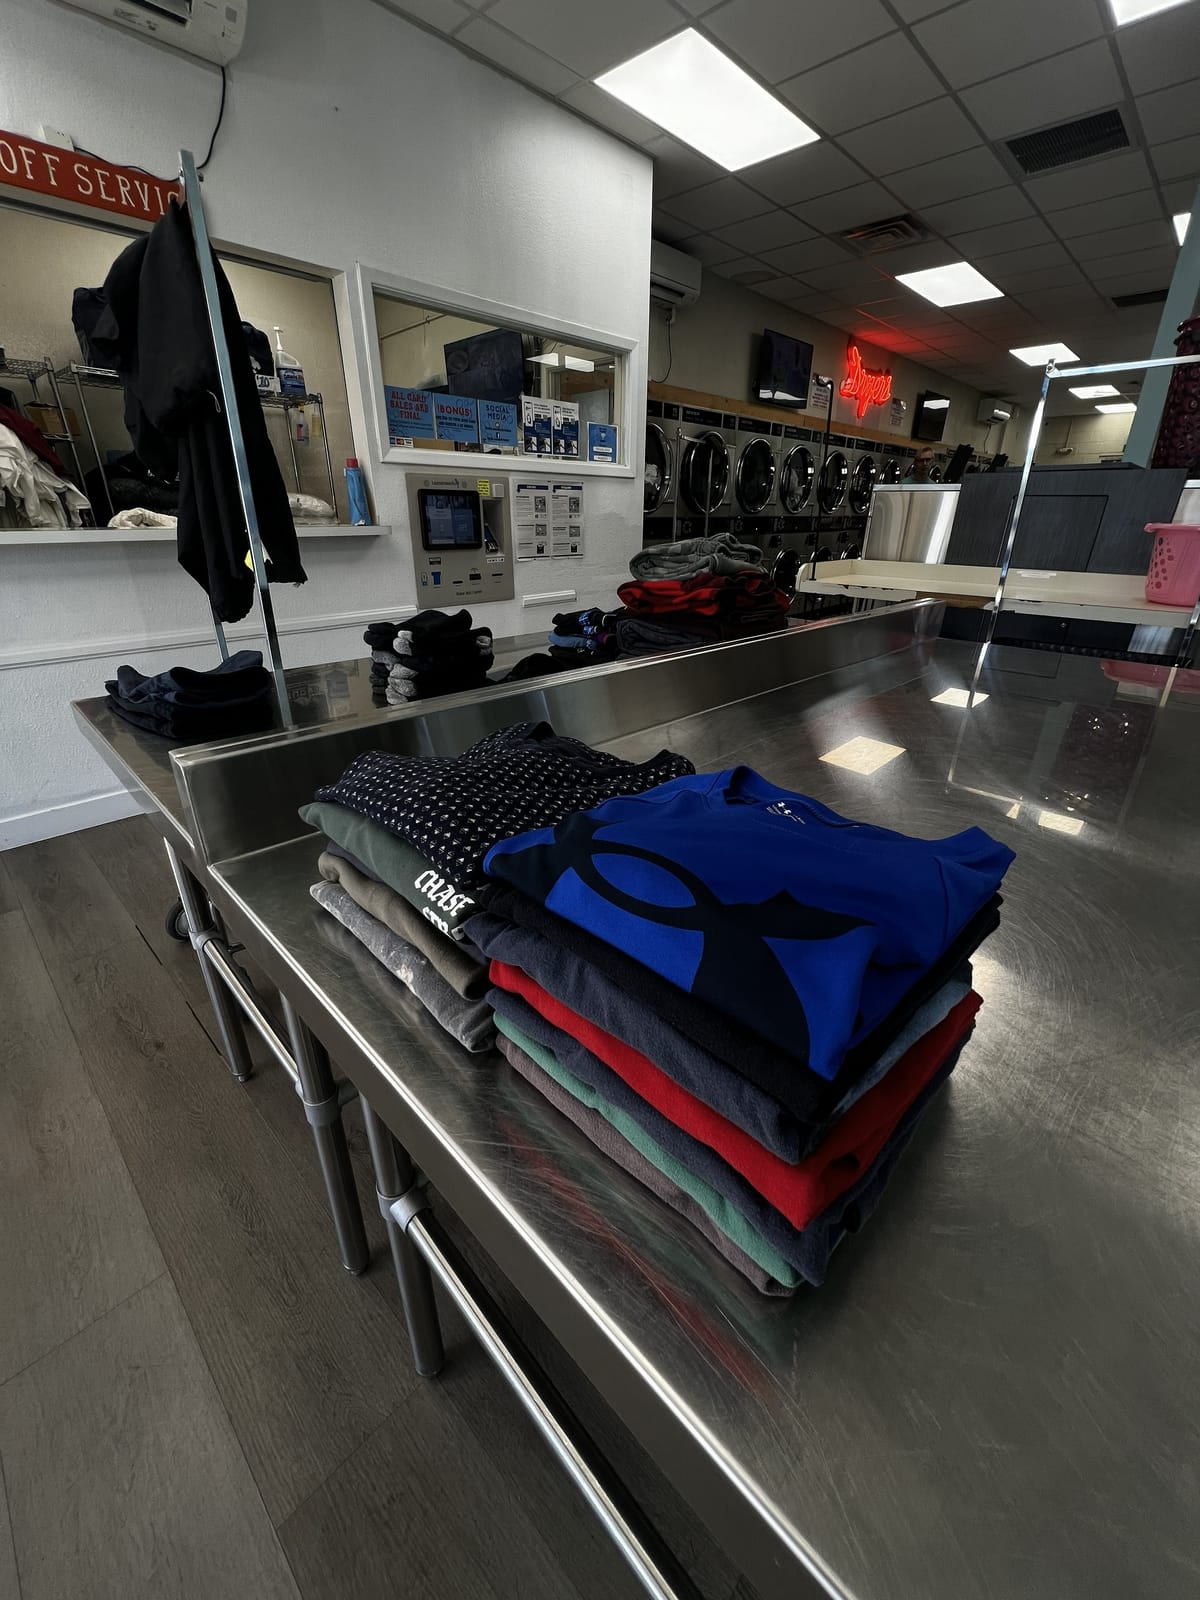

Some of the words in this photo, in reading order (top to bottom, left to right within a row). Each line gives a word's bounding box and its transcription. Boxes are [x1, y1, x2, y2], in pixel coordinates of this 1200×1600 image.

[0, 139, 60, 187] OFF
[840, 345, 893, 417] Dryers
[391, 391, 406, 400] ALL
[407, 393, 427, 403] CARD
[390, 399, 413, 410] SALES
[415, 403, 429, 413] ARE
[485, 404, 510, 415] SOCIAL
[399, 410, 421, 421] FINAL
[487, 412, 507, 422] MEDIA
